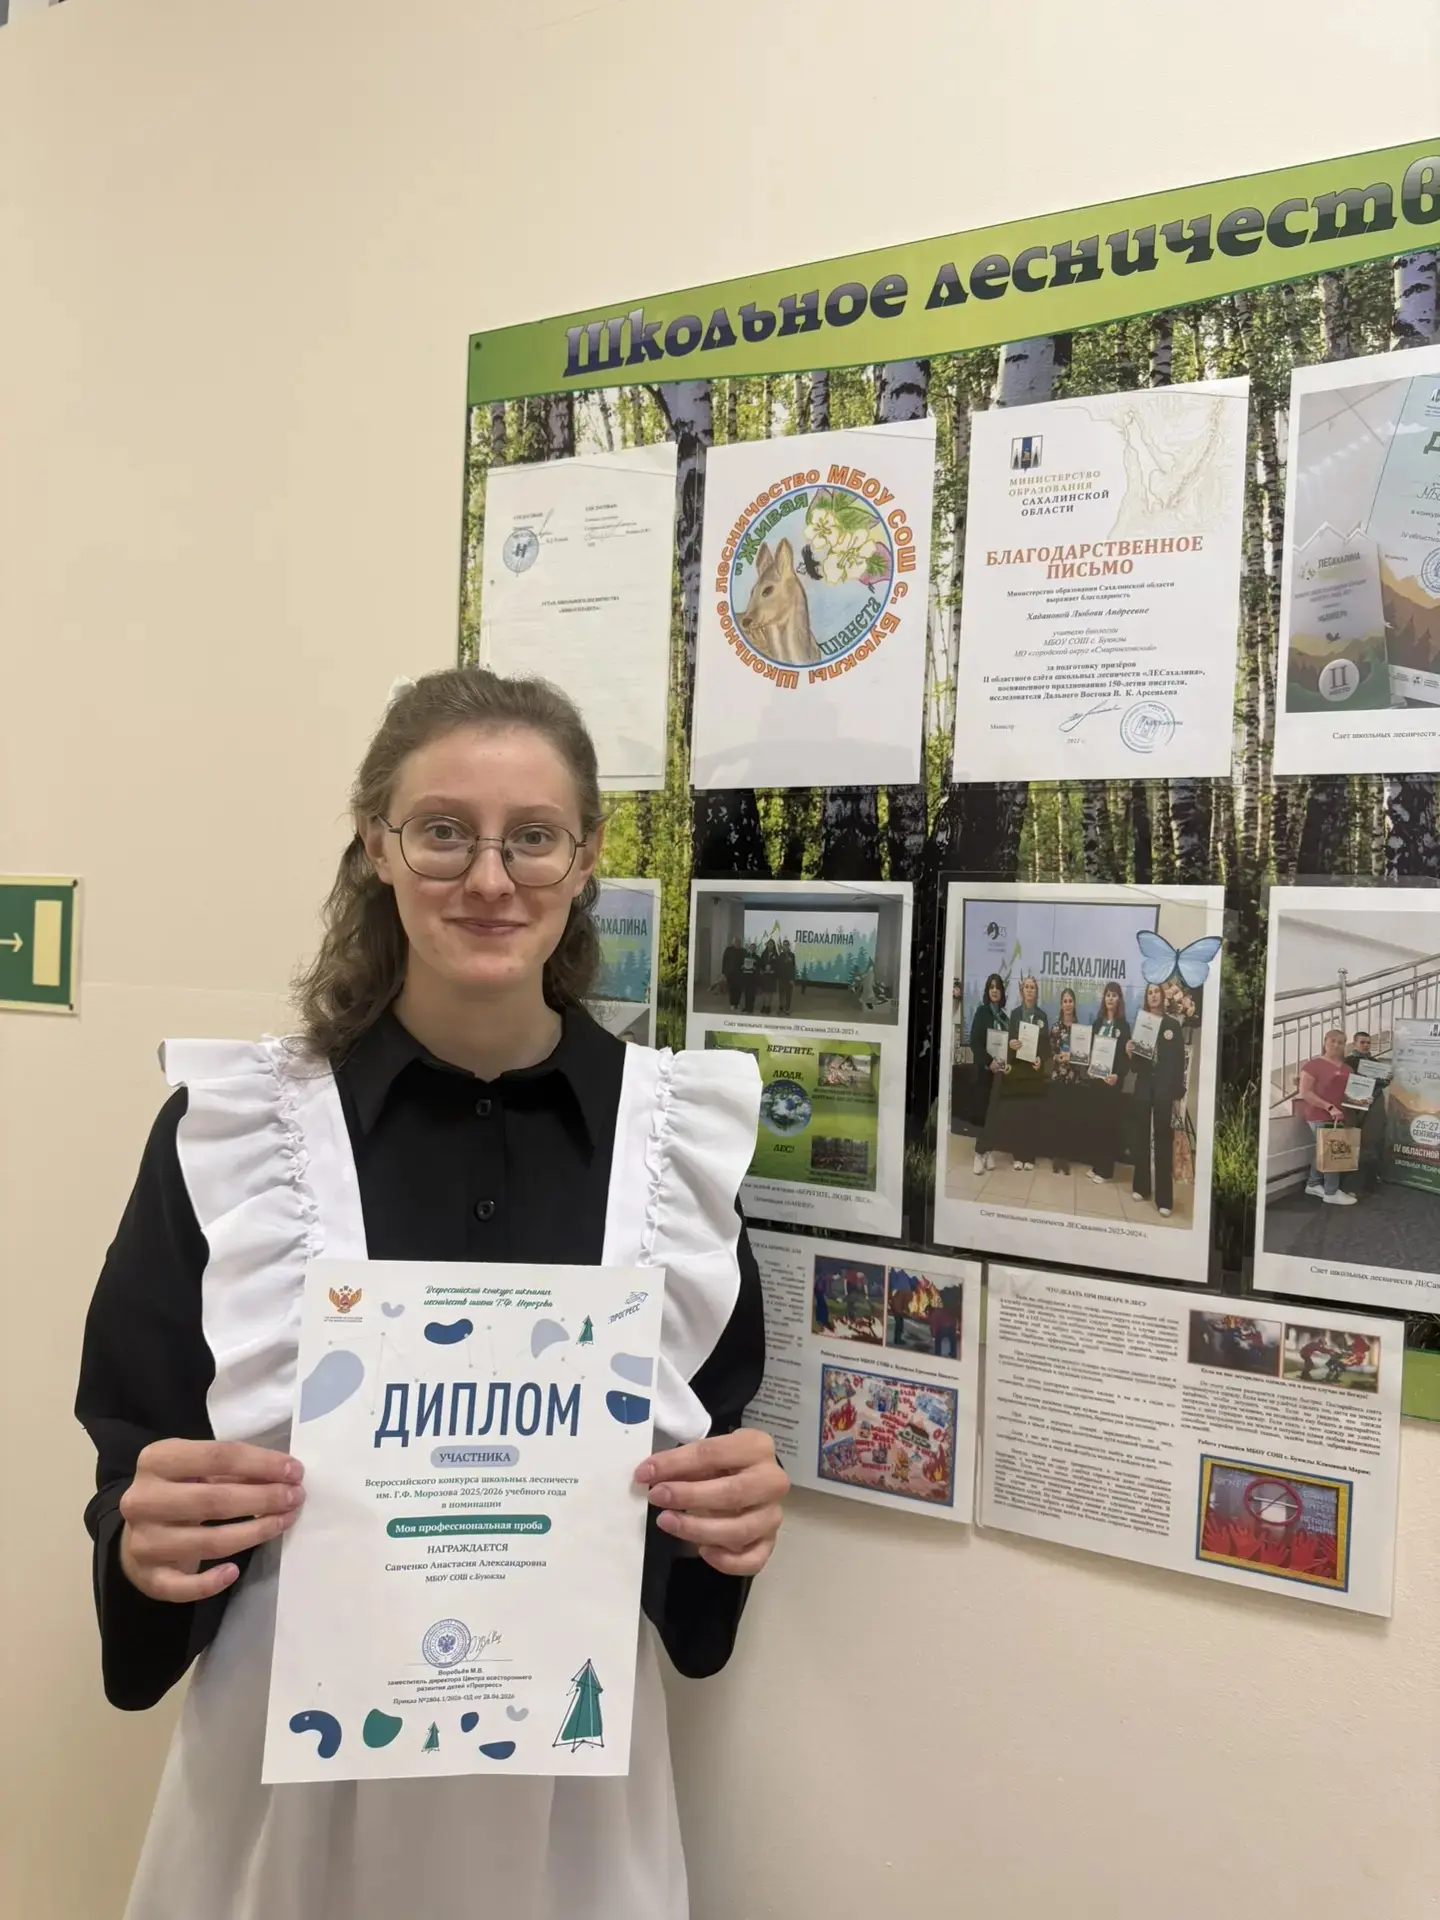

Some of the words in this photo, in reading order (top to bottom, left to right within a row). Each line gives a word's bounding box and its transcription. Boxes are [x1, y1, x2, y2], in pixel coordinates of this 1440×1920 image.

[563, 269, 908, 377] Школьное
[1009, 471, 1100, 486] МИНИСТЕРСТВО
[827, 465, 895, 507] МБОУ
[1009, 482, 1092, 497] ОБРАЗОВАНИЯ
[1022, 490, 1109, 506] САХАЛИНСКОЙ
[1021, 505, 1074, 516] ОБЛАСТИ
[716, 470, 820, 593] лесничество
[887, 508, 916, 573] СОШ
[986, 536, 1204, 566] БЛАГОДАРСТВЕННОЕ
[1046, 559, 1133, 579] ПИСЬМО
[890, 582, 909, 604] с.
[1007, 589, 1054, 598] Министерство
[1055, 586, 1097, 595] образования
[1099, 583, 1145, 591] Сахалинской
[1146, 581, 1175, 589] области
[1046, 595, 1079, 603] выражает
[1105, 607, 1149, 616] Андреевне
[716, 600, 799, 689] Школьное
[1044, 638, 1067, 646] МБОУ
[1068, 637, 1089, 645] СОШ
[1056, 663, 1098, 671] подготовку
[991, 674, 1032, 683] областного
[1054, 673, 1095, 681] школьных
[1097, 672, 1141, 680] лесничеств
[1108, 680, 1146, 688] 150-летия
[989, 693, 1041, 701] исследователя
[1043, 692, 1079, 700] Дальнего
[1080, 690, 1111, 698] Востока
[1136, 688, 1178, 696] Арсеньева
[1330, 1270, 1369, 1280] школьных
[1370, 1275, 1413, 1285] лесничеств
[482, 1287, 513, 1297] конкурс
[515, 1299, 553, 1310] Морозова
[373, 1382, 582, 1448] ДИПЛОМ
[439, 1453, 511, 1463] УЧАСТНИКА
[365, 1478, 436, 1488] Всероссийского
[438, 1477, 479, 1486] конкурса
[481, 1476, 527, 1484] школьных
[529, 1475, 579, 1484] лесничеств
[394, 1490, 412, 1499] Г.Ф.
[414, 1489, 458, 1499] Морозова
[460, 1487, 503, 1497] 2025/2026
[505, 1487, 545, 1497] учебного
[547, 1489, 567, 1497] года
[448, 1501, 502, 1510] номинации
[395, 1524, 416, 1533] Моя
[418, 1522, 512, 1534] профессиональная
[514, 1521, 543, 1531] проба
[427, 1543, 509, 1554] НАГРАЖДАЕТСЯ
[385, 1562, 428, 1571] Савченко
[430, 1561, 477, 1569] Анастасия
[479, 1559, 547, 1568] Александровна
[425, 1575, 448, 1583] МБОУ
[469, 1573, 506, 1582] с.Буюклы
[428, 1677, 462, 1685] директора
[486, 1674, 532, 1682] всестороннего
[416, 1684, 446, 1692] развития
[466, 1682, 502, 1690] «Прогресс»
